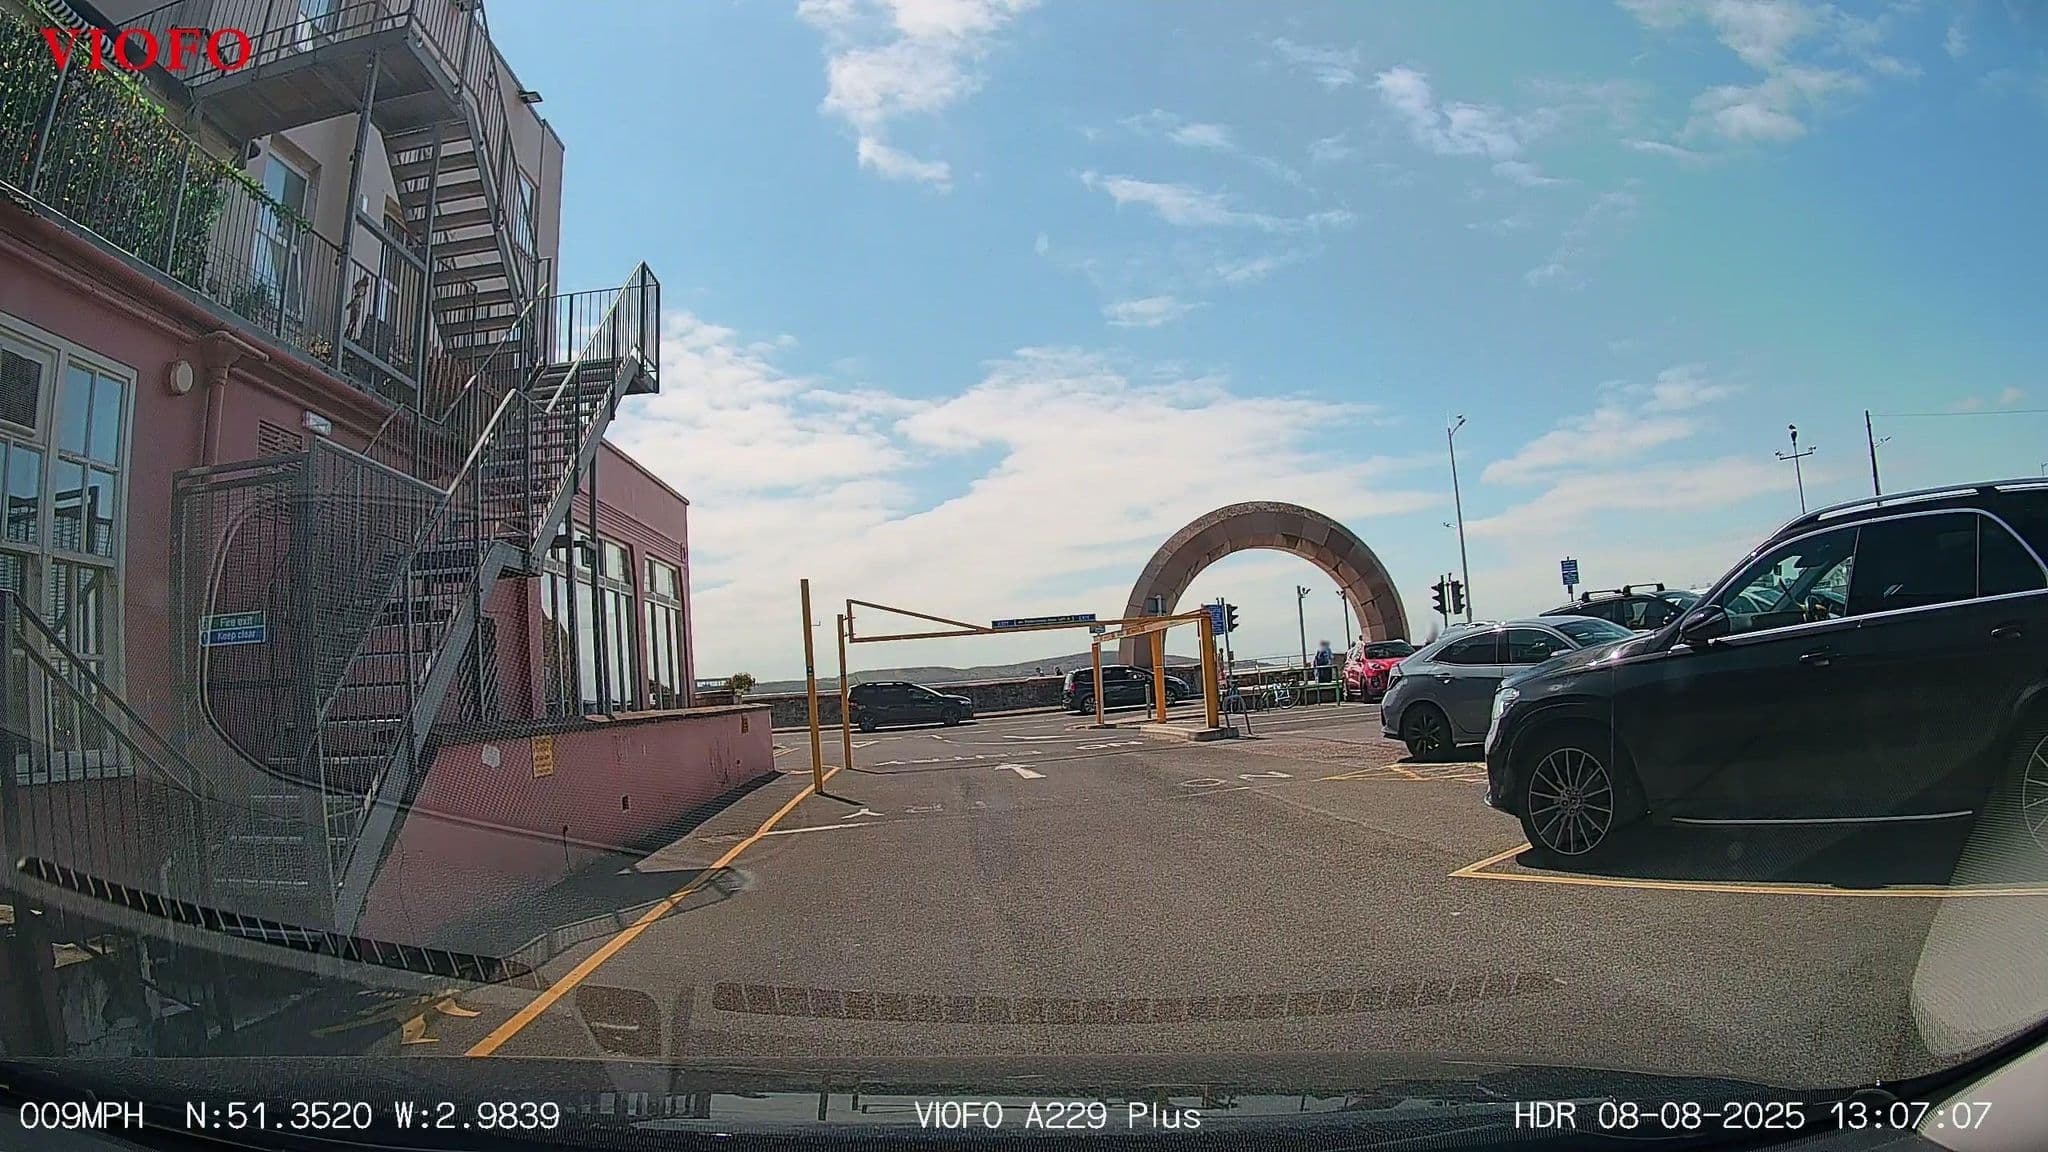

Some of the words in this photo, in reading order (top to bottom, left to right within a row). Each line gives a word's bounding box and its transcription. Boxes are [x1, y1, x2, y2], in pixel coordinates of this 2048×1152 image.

[220, 617, 236, 628] Fire
[237, 615, 254, 626] exit
[217, 631, 237, 641] Keep
[237, 629, 256, 639] clear
